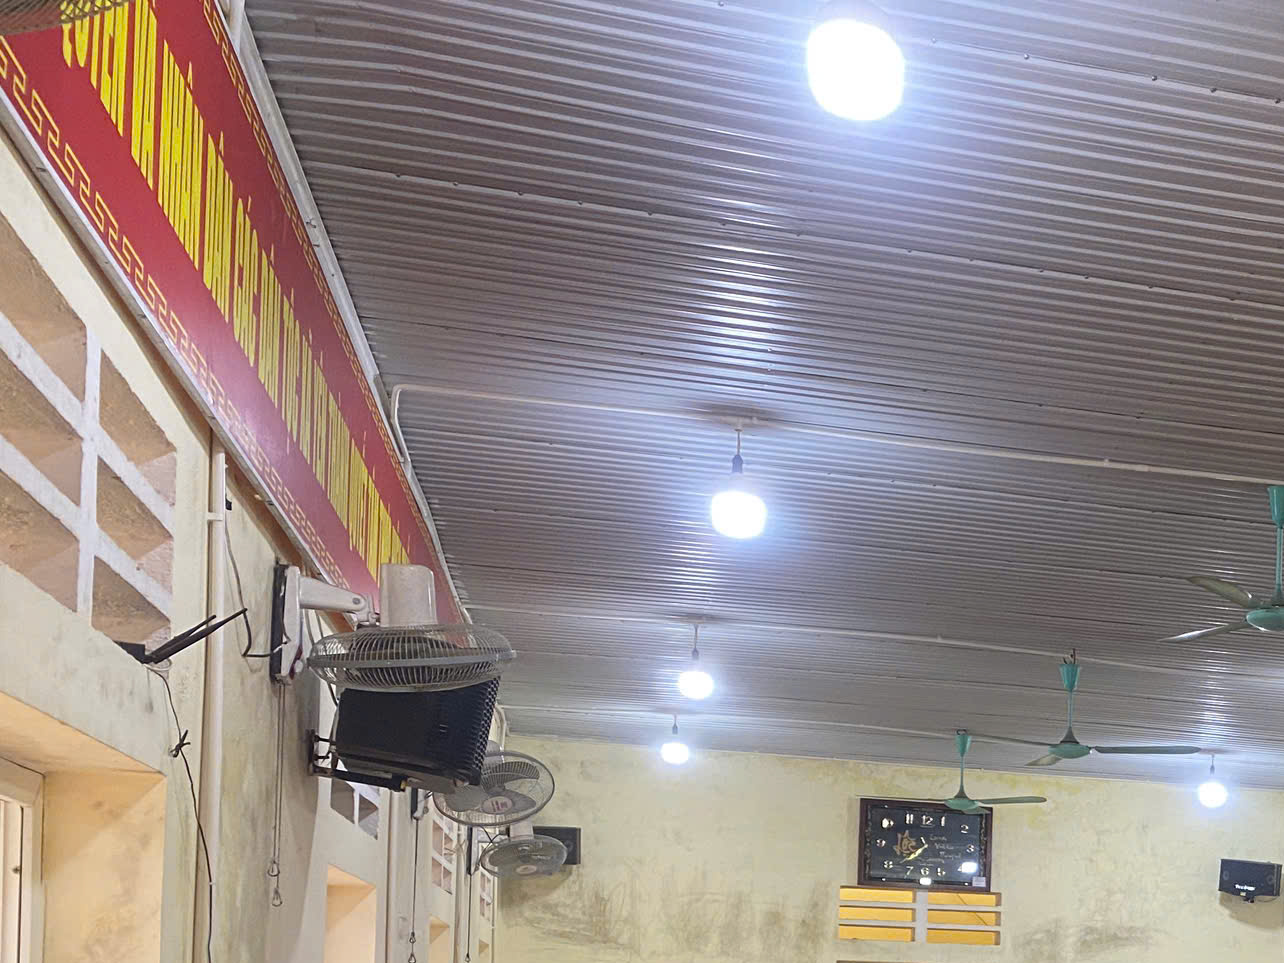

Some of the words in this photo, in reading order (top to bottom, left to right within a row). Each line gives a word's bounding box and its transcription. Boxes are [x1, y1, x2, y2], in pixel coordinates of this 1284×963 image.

[157, 38, 204, 272] NHÂN
[203, 130, 234, 325] DÂN
[233, 195, 260, 369] CÁC
[258, 243, 281, 409] DÂN
[281, 288, 300, 455] TỘC
[906, 866, 914, 876] 7
